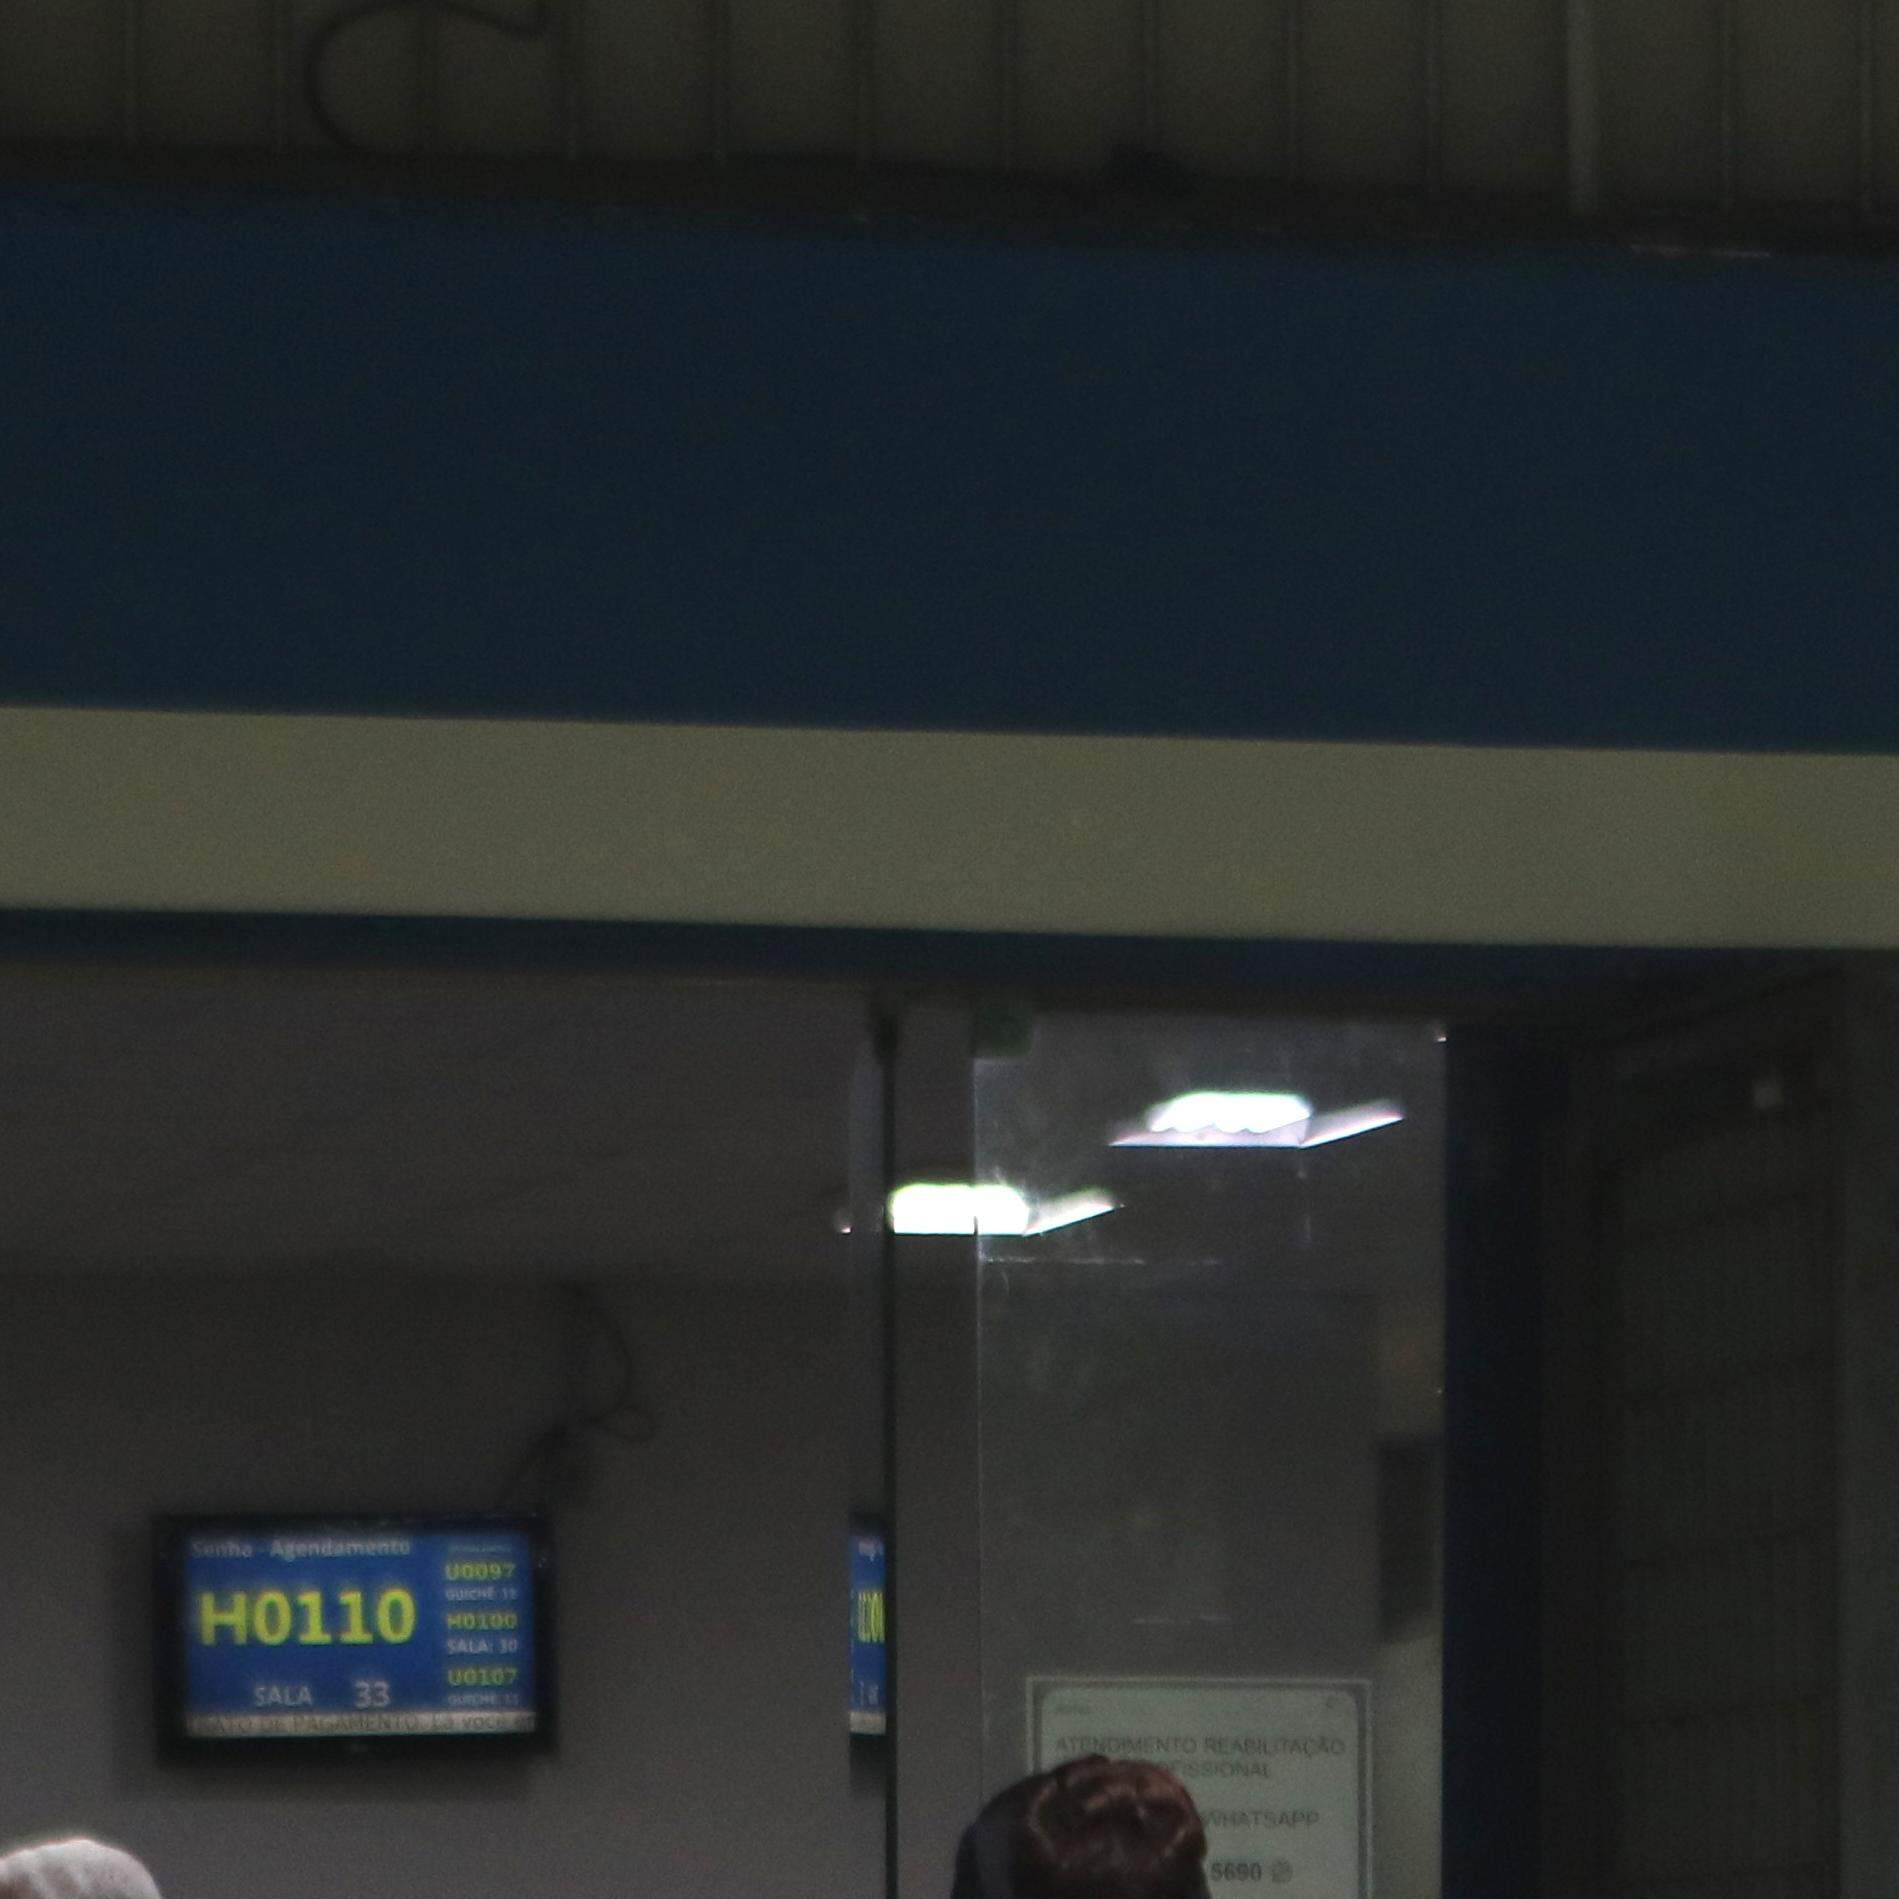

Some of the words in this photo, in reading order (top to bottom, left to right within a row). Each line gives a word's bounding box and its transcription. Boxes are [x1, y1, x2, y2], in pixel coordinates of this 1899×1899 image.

[201, 1588, 417, 1646] H0110
[254, 1682, 313, 1707] SALA
[353, 1680, 391, 1709] 33
[1055, 1736, 1197, 1754] ATENDIMENTO
[1204, 1735, 1346, 1758] REABILITAÇÃO
